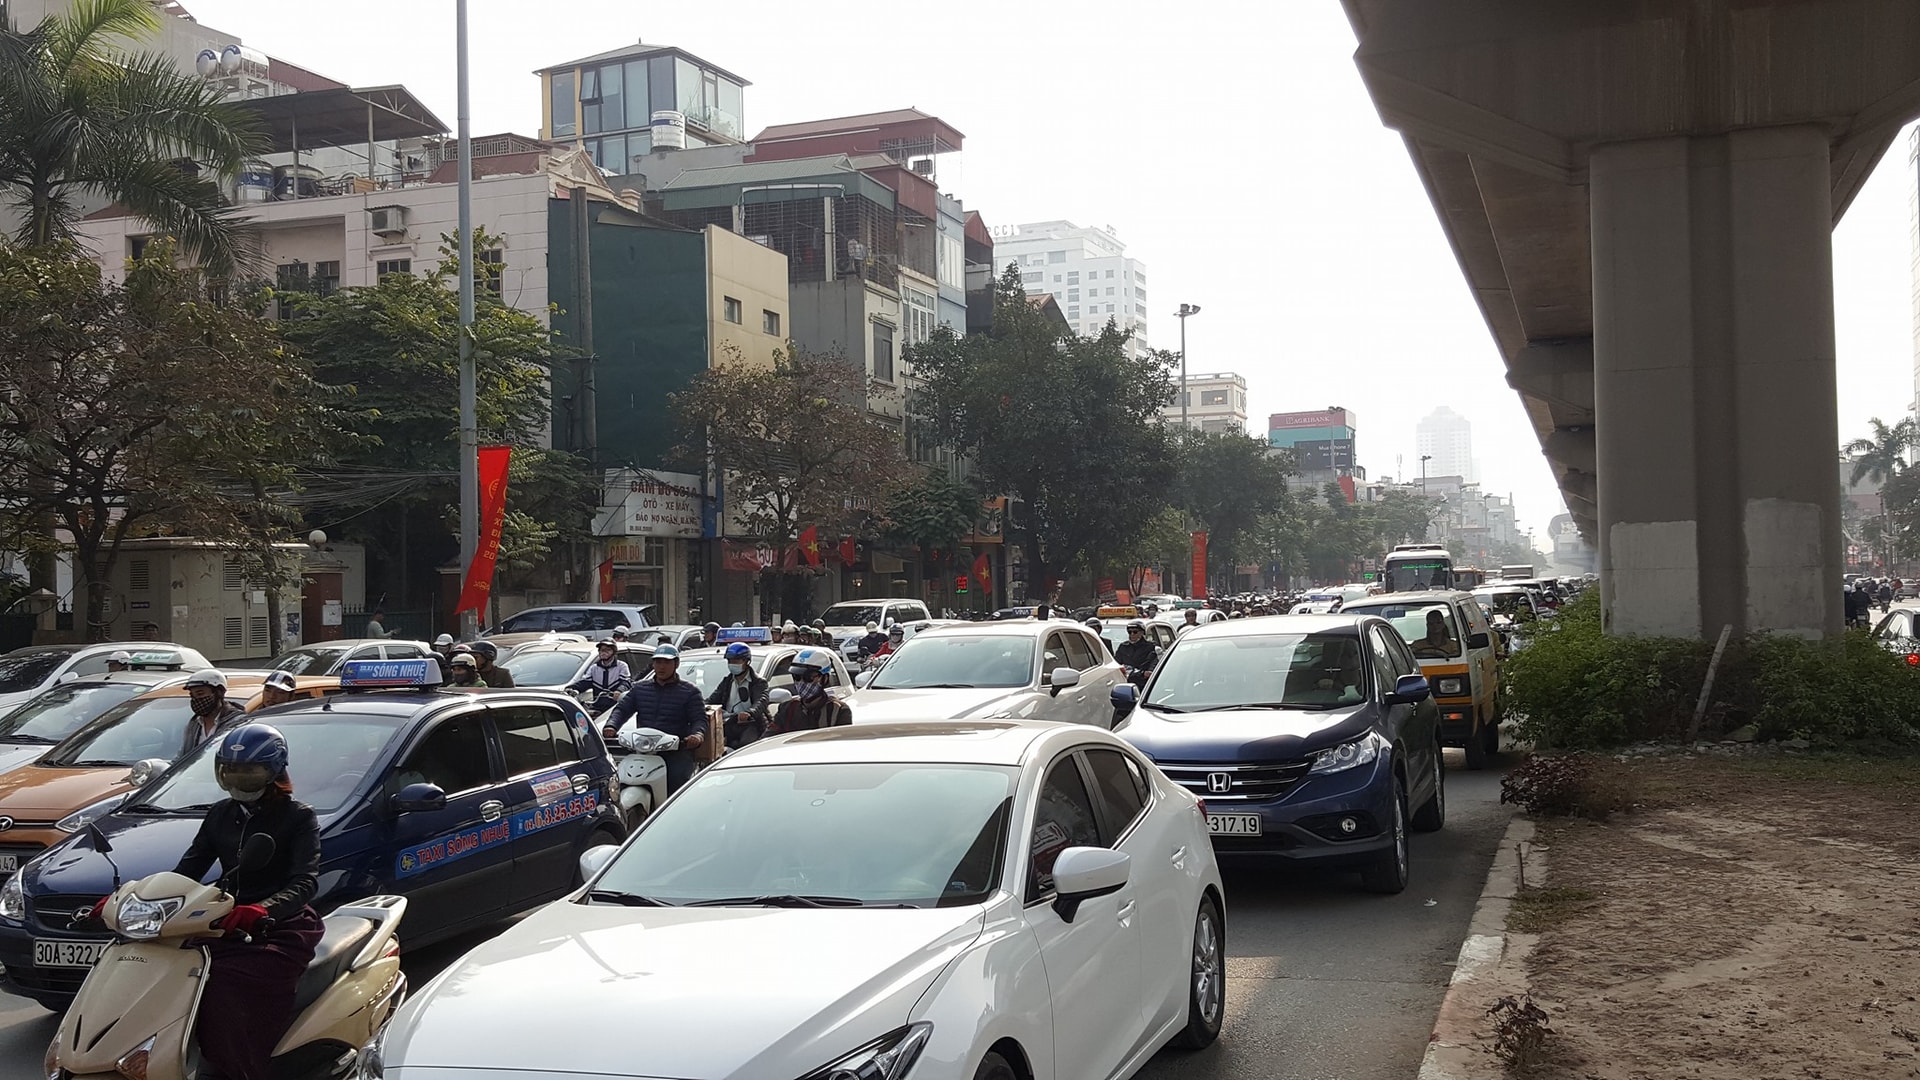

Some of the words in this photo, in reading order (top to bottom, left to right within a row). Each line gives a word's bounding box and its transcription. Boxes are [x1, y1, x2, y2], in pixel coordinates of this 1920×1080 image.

[372, 662, 399, 678] SÔNG
[417, 844, 445, 865] TAXI
[447, 832, 479, 857] SÔNG
[481, 818, 510, 846] NHUỆ
